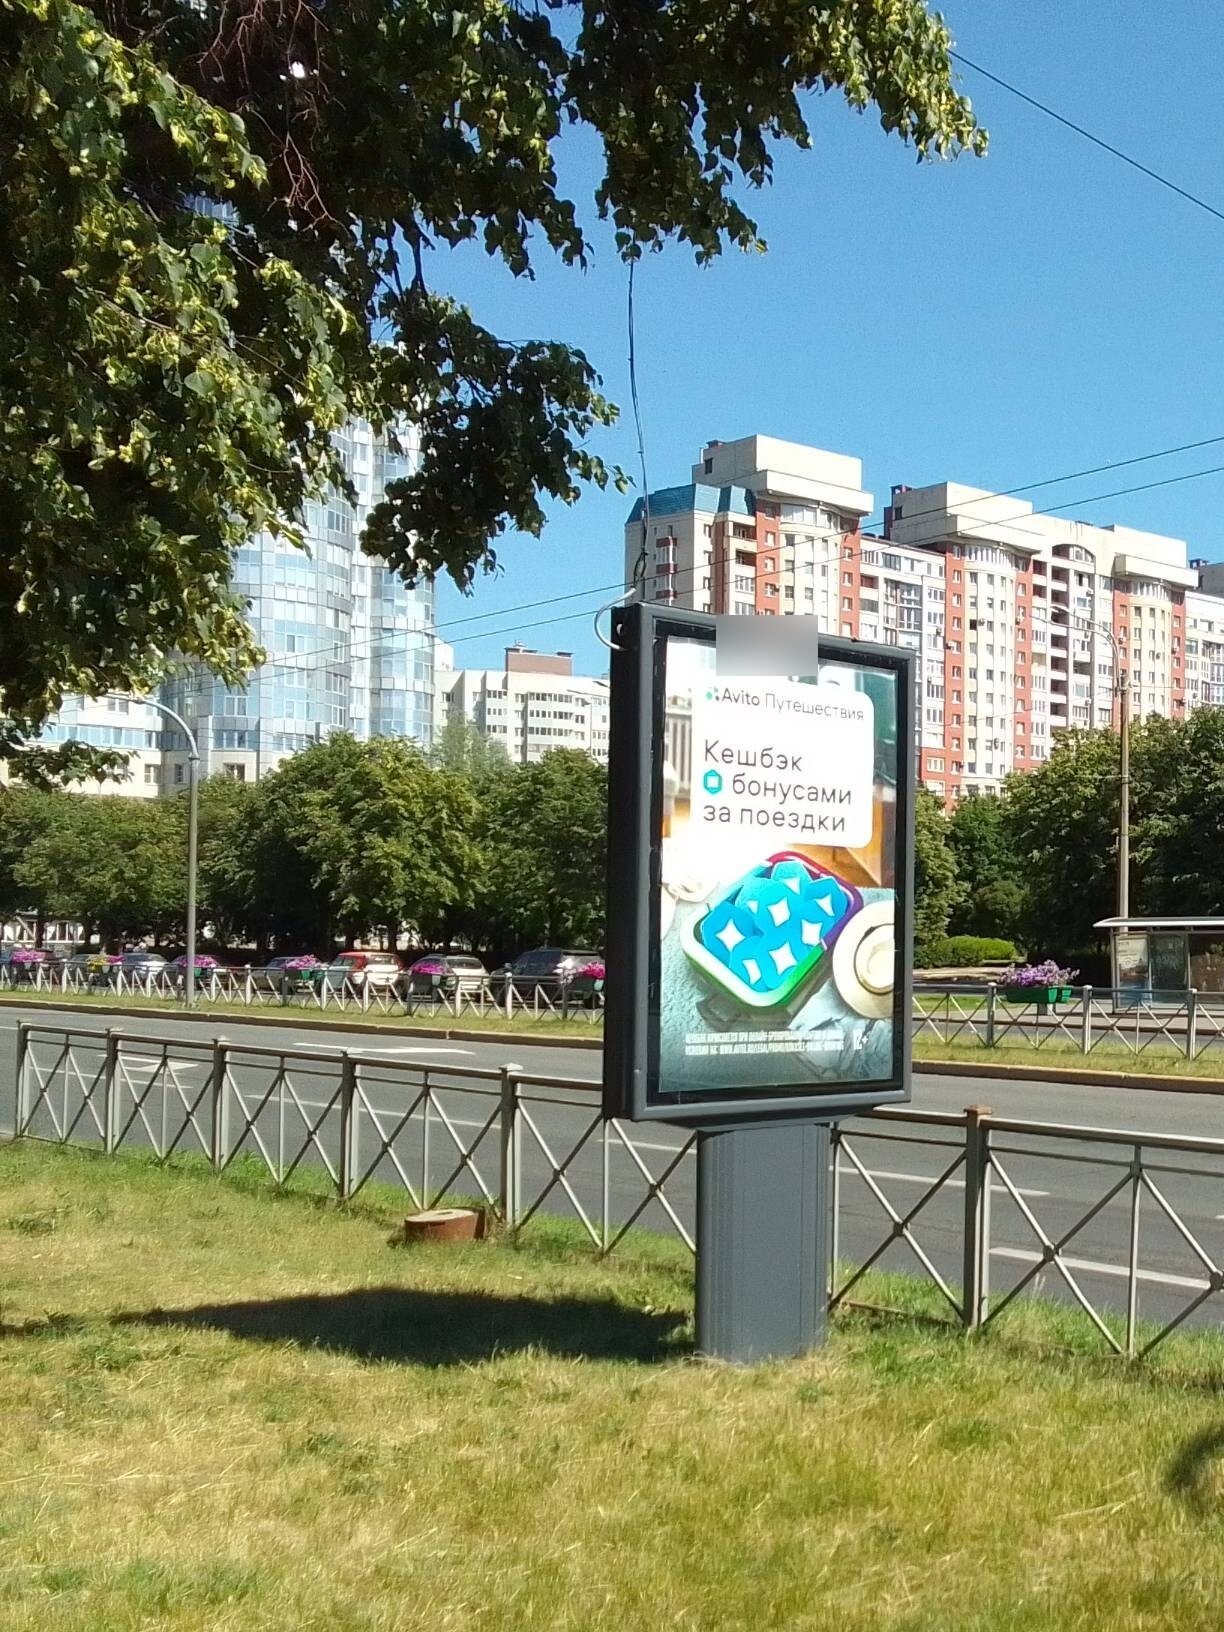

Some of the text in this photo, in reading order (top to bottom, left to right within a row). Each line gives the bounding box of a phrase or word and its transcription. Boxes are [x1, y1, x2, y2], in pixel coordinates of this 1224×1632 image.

[721, 687, 864, 720] Avito Путешествия
[704, 739, 802, 772] Кешбэк
[732, 772, 852, 805] бонусами
[703, 805, 846, 833] за поездки
